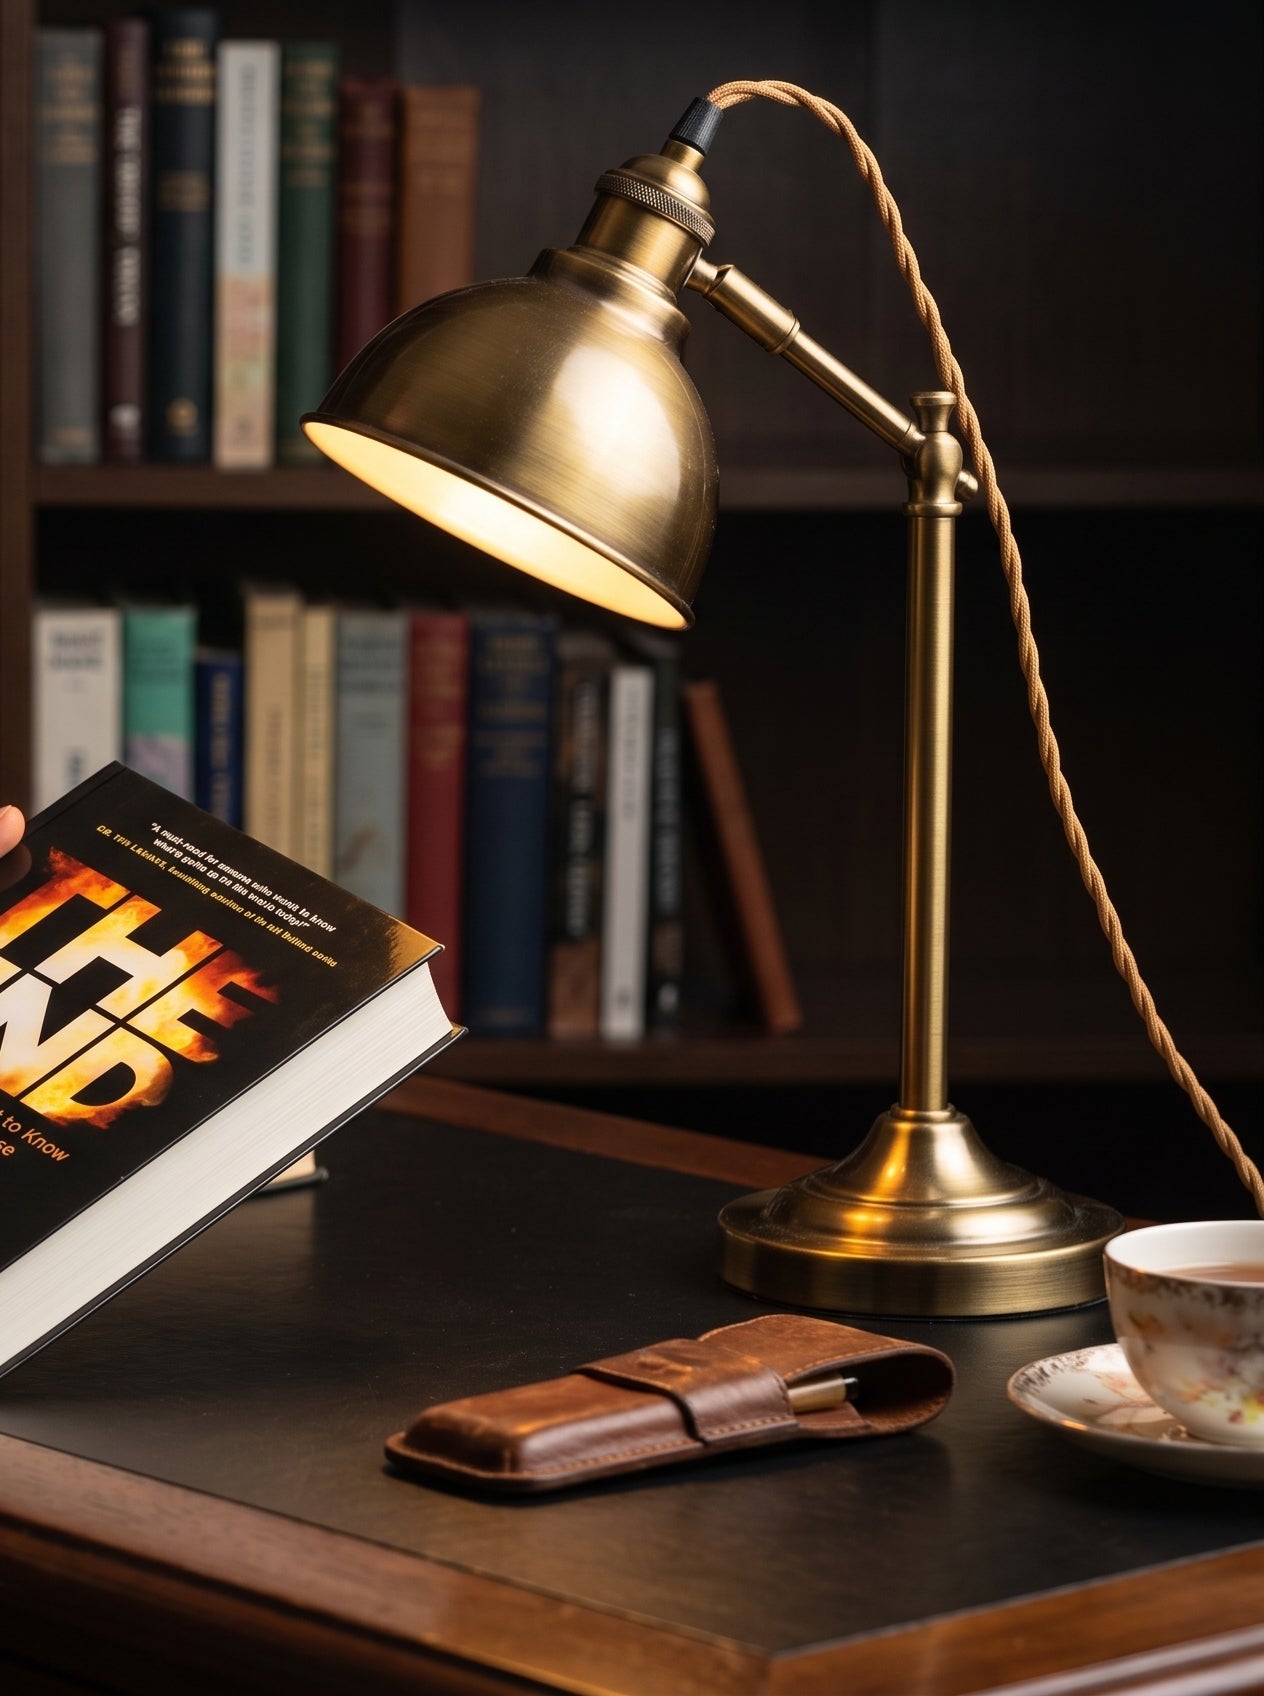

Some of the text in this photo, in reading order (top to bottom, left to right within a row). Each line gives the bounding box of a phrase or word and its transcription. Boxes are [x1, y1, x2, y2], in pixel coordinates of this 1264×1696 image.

[309, 914, 337, 932] know
[2, 1115, 22, 1133] to
[21, 1128, 70, 1162] Know
